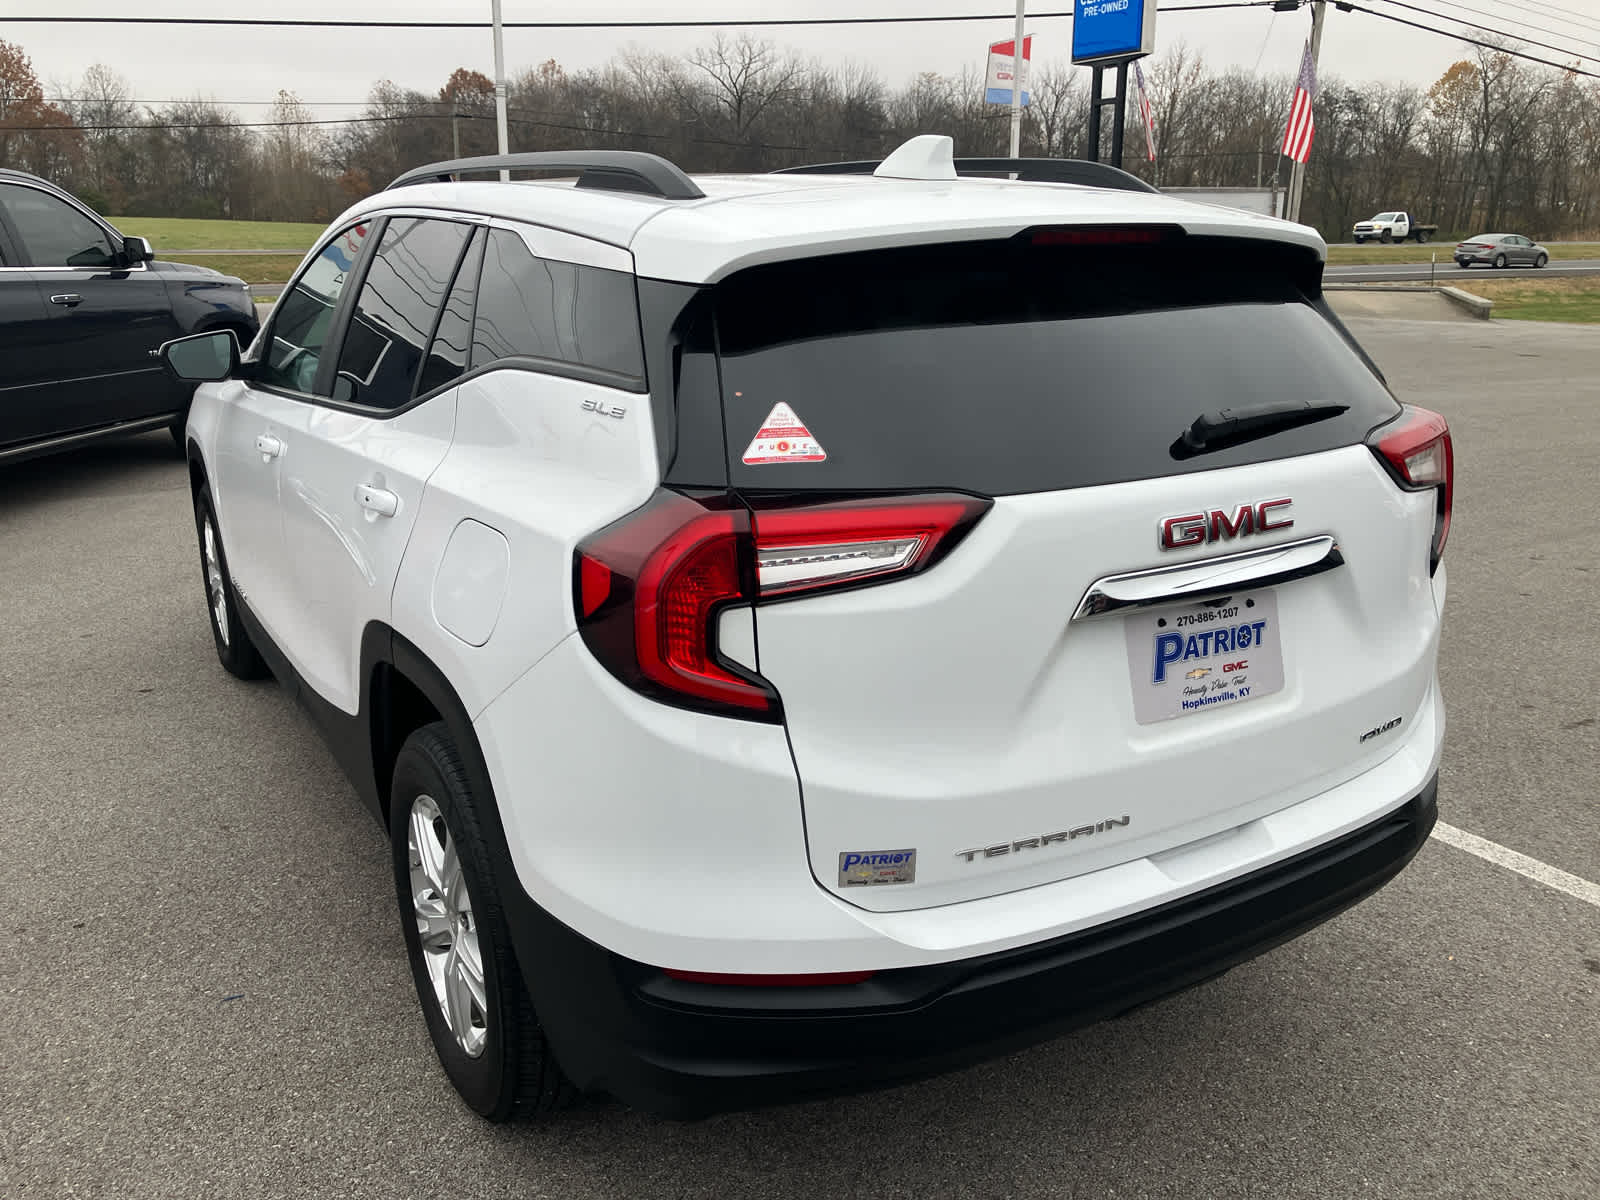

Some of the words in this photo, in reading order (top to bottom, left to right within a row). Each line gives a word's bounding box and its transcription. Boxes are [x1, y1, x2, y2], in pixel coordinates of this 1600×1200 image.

[1084, 0, 1129, 17] PRE-OWNED
[580, 400, 626, 419] SLE
[758, 442, 808, 452] PULSE
[1158, 497, 1294, 551] GMC
[1176, 607, 1239, 627] 270-886-1207
[1153, 621, 1266, 684] PATRIOT
[1222, 660, 1249, 673] GMC
[1182, 692, 1238, 711] Hopkinsville,
[1239, 687, 1252, 698] KY
[954, 814, 1131, 862] TERRAIN
[842, 852, 912, 872] PATRIOT
